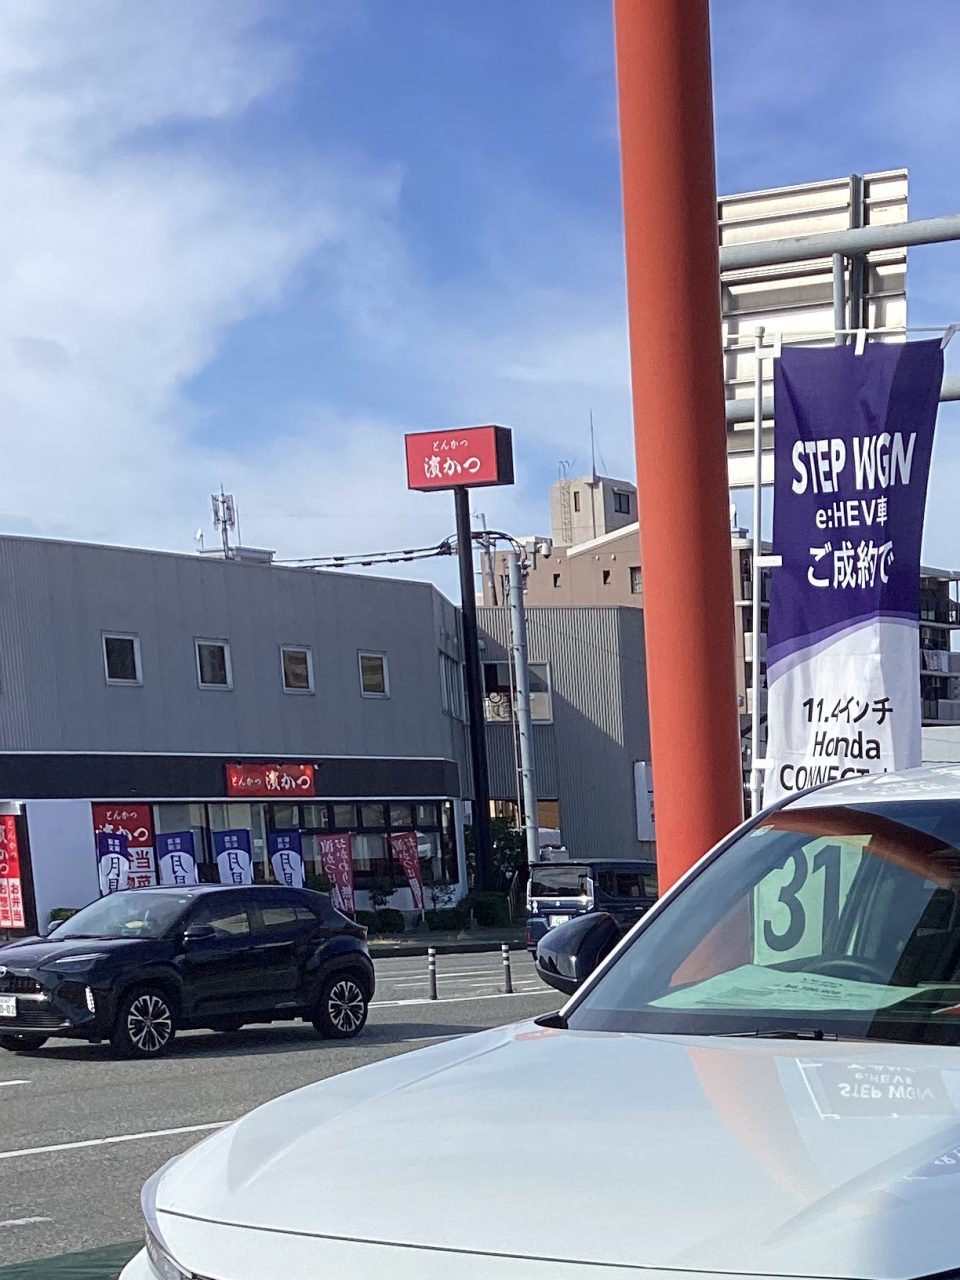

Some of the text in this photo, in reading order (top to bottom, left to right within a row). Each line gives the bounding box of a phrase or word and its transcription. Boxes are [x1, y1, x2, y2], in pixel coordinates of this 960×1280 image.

[432, 439, 468, 452] とんかつ
[792, 432, 916, 494] STEP WGN
[815, 495, 888, 529] e:HEV車
[807, 540, 894, 589] ご成約で
[812, 730, 881, 760] Honda
[231, 776, 261, 787] とんかつ
[105, 810, 138, 821] とんかつ
[763, 843, 842, 955] 31
